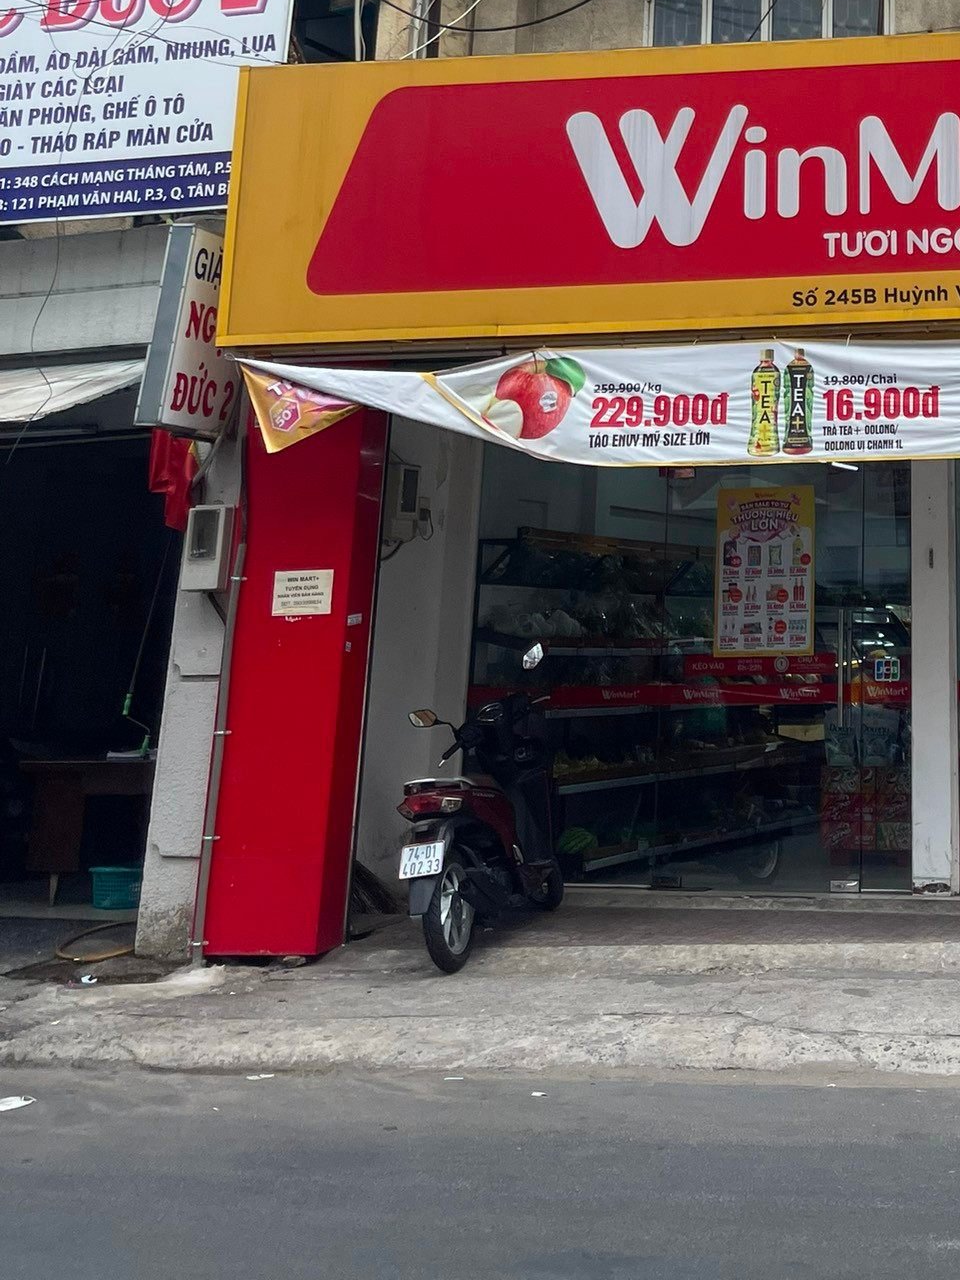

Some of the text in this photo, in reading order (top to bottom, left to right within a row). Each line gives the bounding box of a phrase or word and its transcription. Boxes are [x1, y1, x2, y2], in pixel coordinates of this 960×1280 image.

[45, 50, 70, 71] ÁO
[166, 37, 235, 60] NHUNG,
[242, 33, 276, 54] LỤA
[41, 76, 77, 98] CÁC
[28, 102, 95, 126] PHÒNG,
[103, 93, 141, 120] GHẾ
[146, 96, 156, 118] Ô
[163, 94, 185, 116] TÔ
[31, 130, 77, 154] THÁO
[83, 125, 120, 150] RÁP
[127, 123, 171, 147] MÀN
[176, 118, 213, 144] CỬA
[13, 176, 38, 189] 348
[41, 170, 80, 188] CÁCH
[81, 170, 124, 186] MẠNG
[128, 163, 176, 182] THÁNG
[179, 161, 211, 178] TÁM,
[11, 198, 34, 211] 121
[38, 194, 79, 211] PHẠM
[80, 190, 110, 206] VĂN
[114, 190, 141, 206] HAI,
[145, 188, 167, 203] P.3,
[171, 187, 184, 202] Q.
[187, 182, 214, 198] TÂN
[823, 229, 897, 258] TƯƠI
[792, 286, 818, 307] Số
[825, 288, 877, 306] 245B
[884, 286, 948, 308] Huỳnh
[590, 391, 729, 428] 229.900đ
[823, 386, 940, 421] 16.900đ
[589, 432, 609, 449] TÁO
[663, 433, 687, 447] SIZE
[689, 430, 710, 446] LỚN
[823, 423, 837, 436] TRÀ
[402, 858, 440, 877] 402.33
[408, 845, 437, 862] 74-D1
